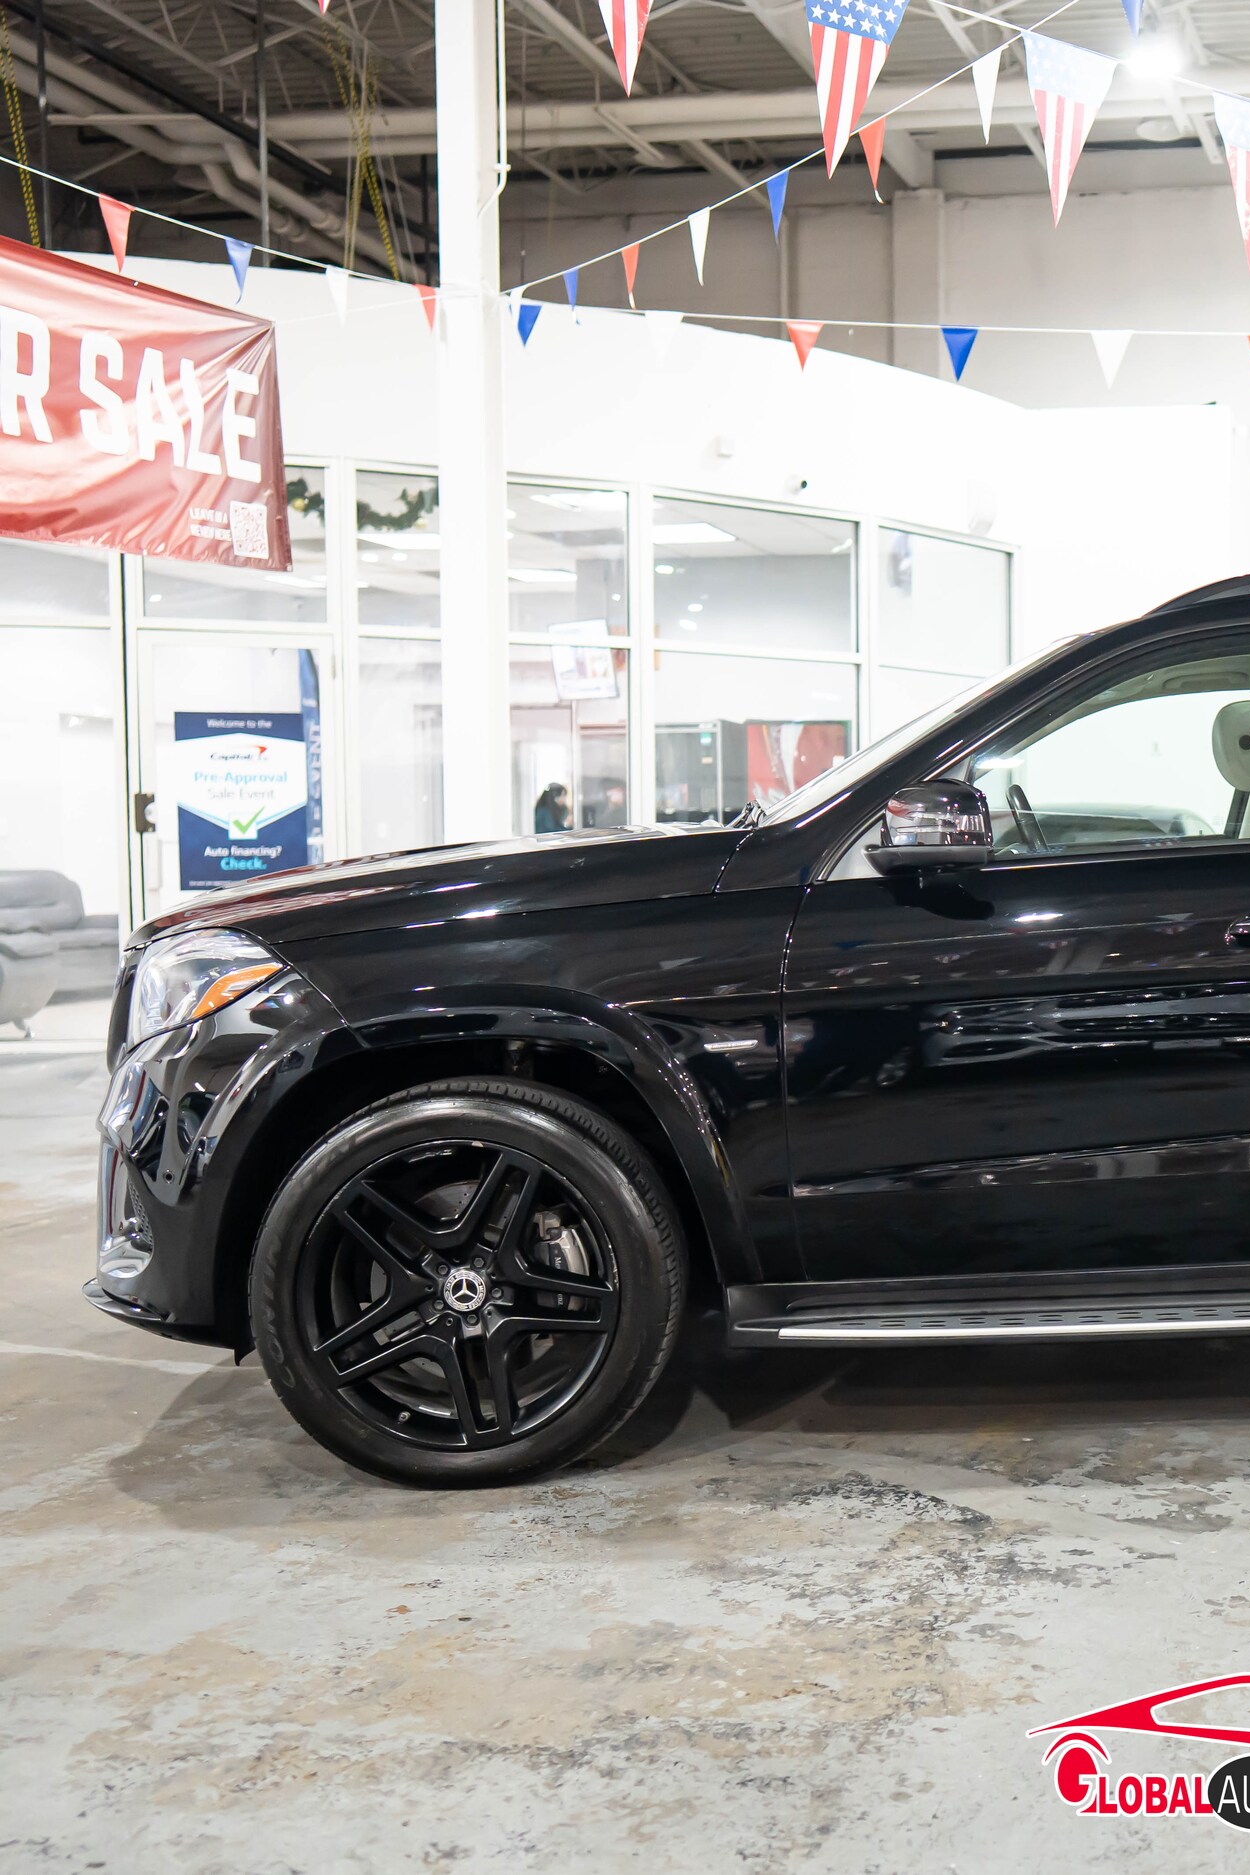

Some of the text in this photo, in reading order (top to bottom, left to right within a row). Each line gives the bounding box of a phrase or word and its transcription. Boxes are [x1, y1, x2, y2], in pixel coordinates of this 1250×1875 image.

[78, 332, 263, 484] SALE
[207, 718, 273, 729] Welcome to the
[194, 771, 288, 785] Pre-Approval
[207, 788, 276, 799] Sale Event
[204, 845, 283, 859] Auto financing?
[219, 857, 268, 871] Check.
